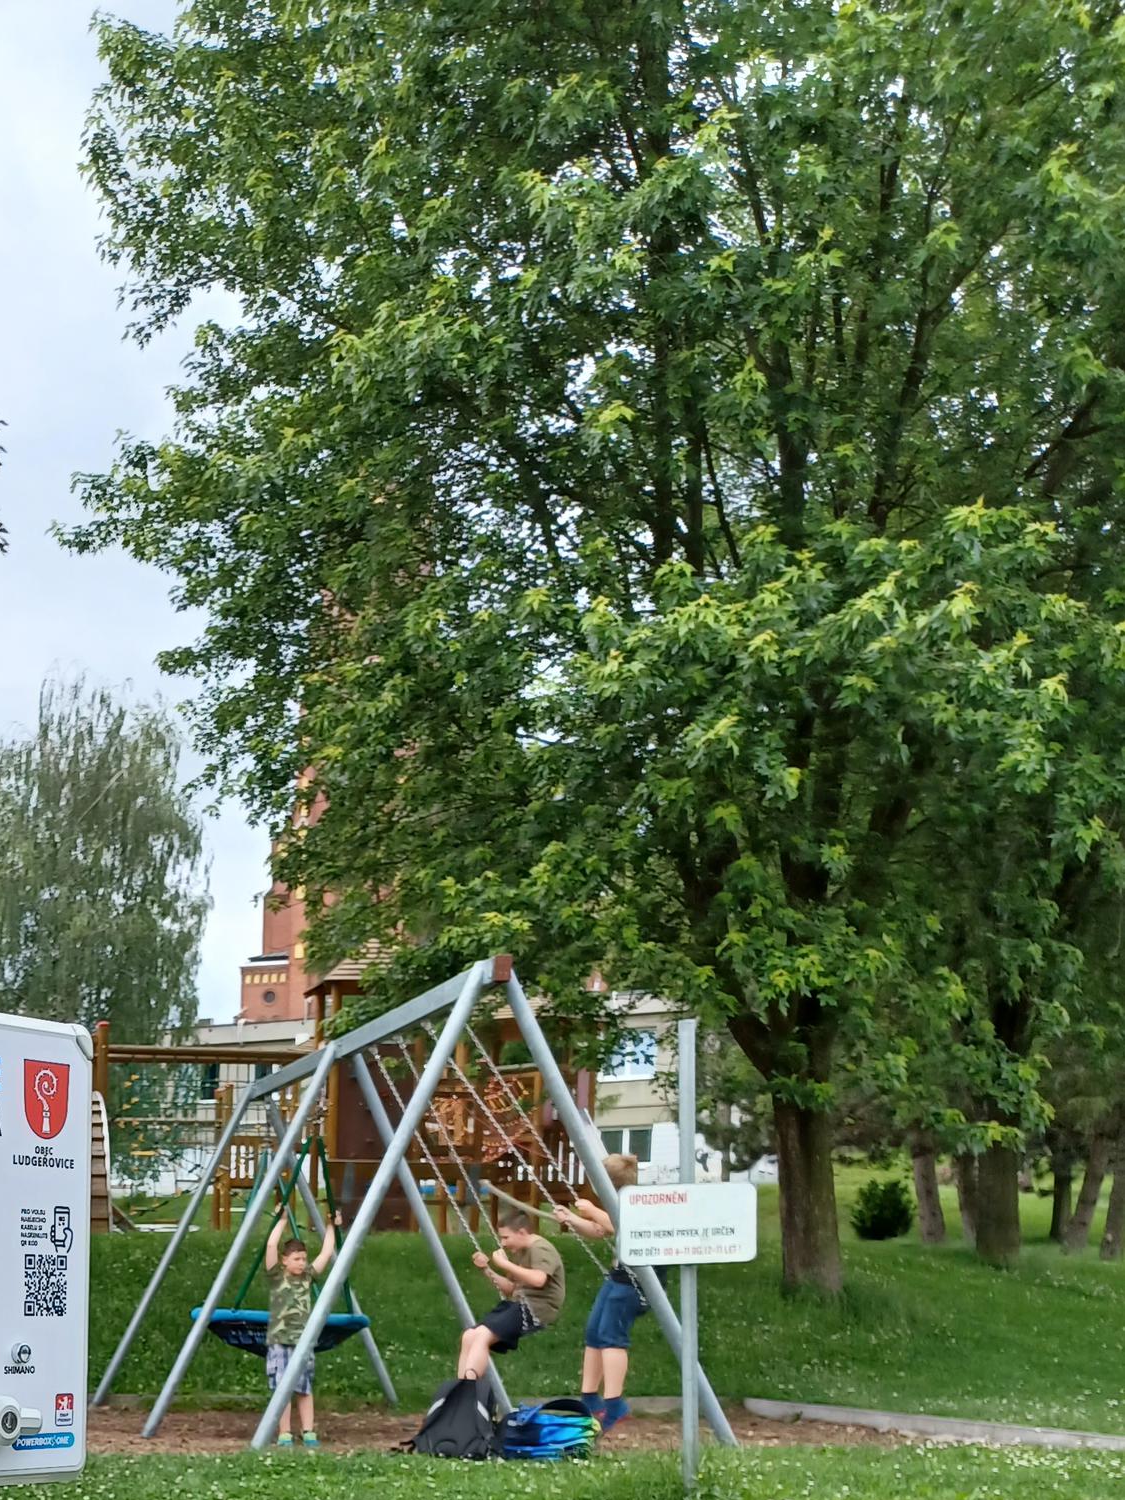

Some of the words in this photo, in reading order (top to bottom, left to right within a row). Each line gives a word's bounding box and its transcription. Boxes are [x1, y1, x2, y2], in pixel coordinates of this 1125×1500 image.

[35, 1146, 53, 1155] OBEC
[13, 1154, 75, 1169] LUDGEŘOVICE
[629, 1191, 687, 1205] UPOZORNĚNÍ
[4, 1366, 35, 1374] SHIMANO
